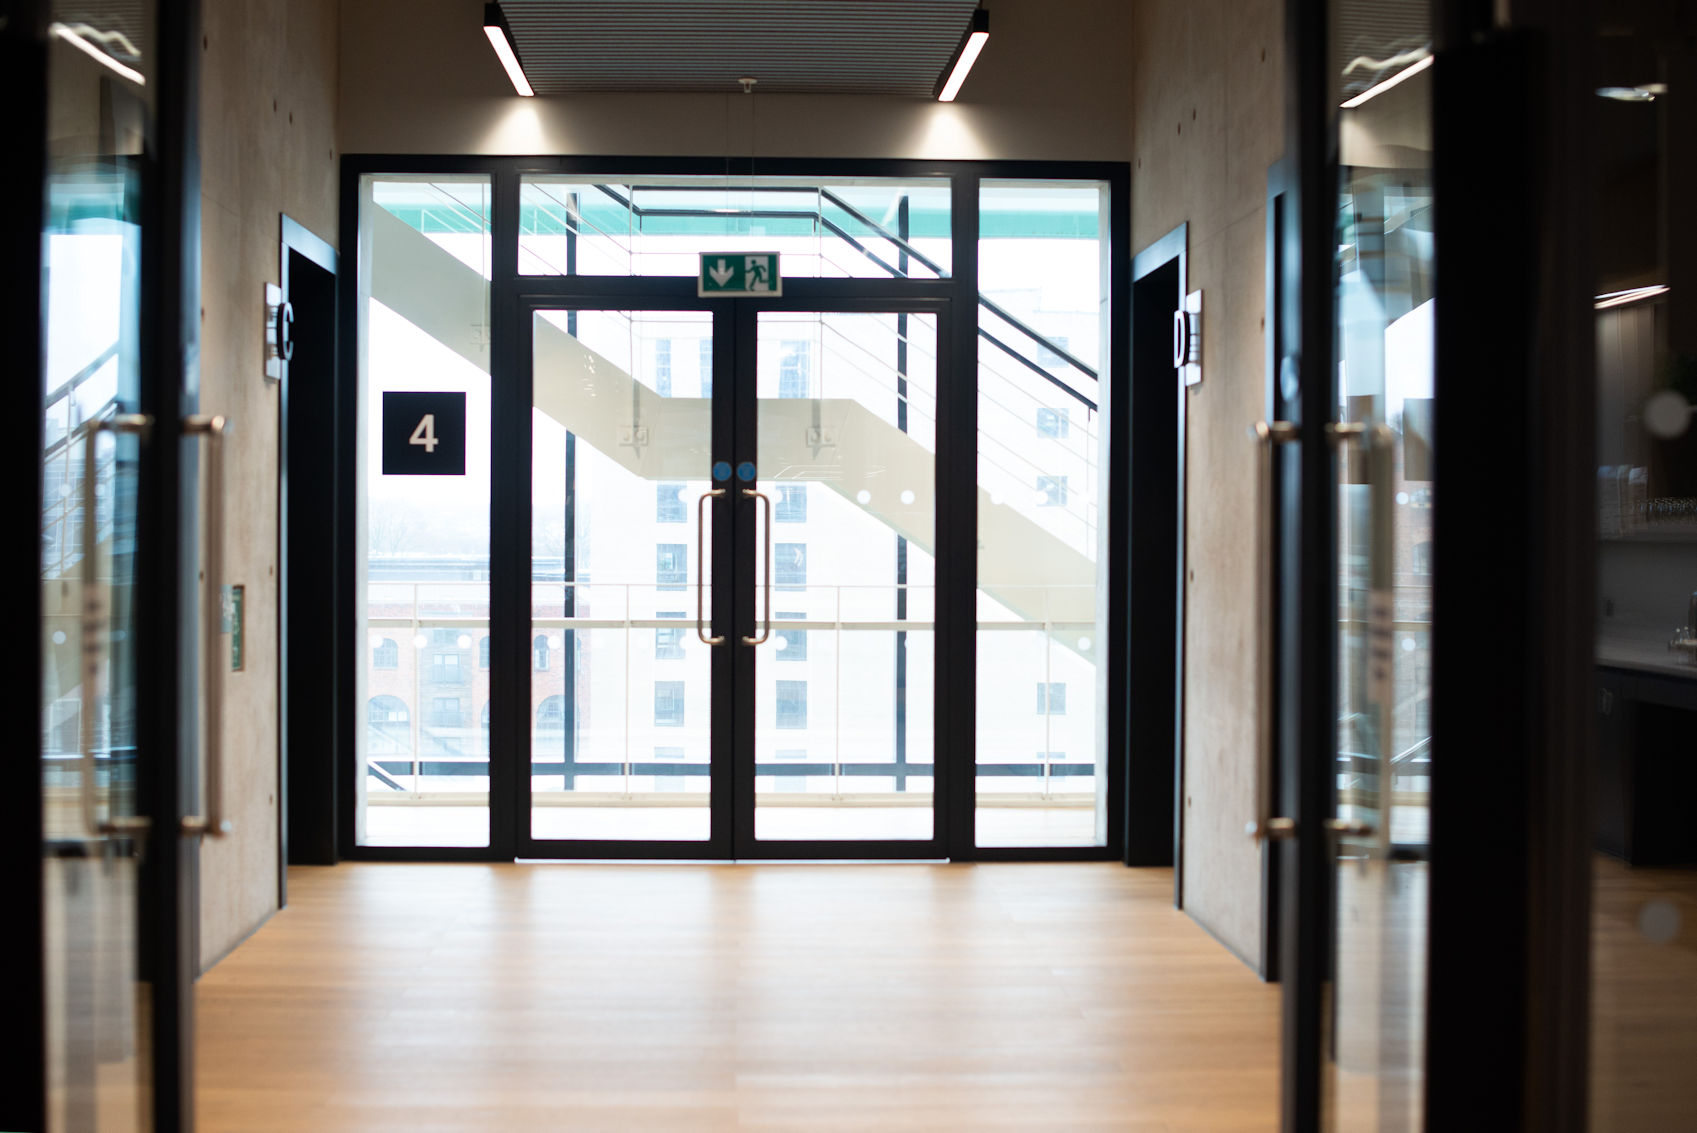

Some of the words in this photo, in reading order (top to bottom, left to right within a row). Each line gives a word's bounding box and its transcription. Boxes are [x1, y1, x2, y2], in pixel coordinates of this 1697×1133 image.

[281, 302, 294, 361] C
[1173, 309, 1187, 369] D
[409, 413, 439, 453] 4
